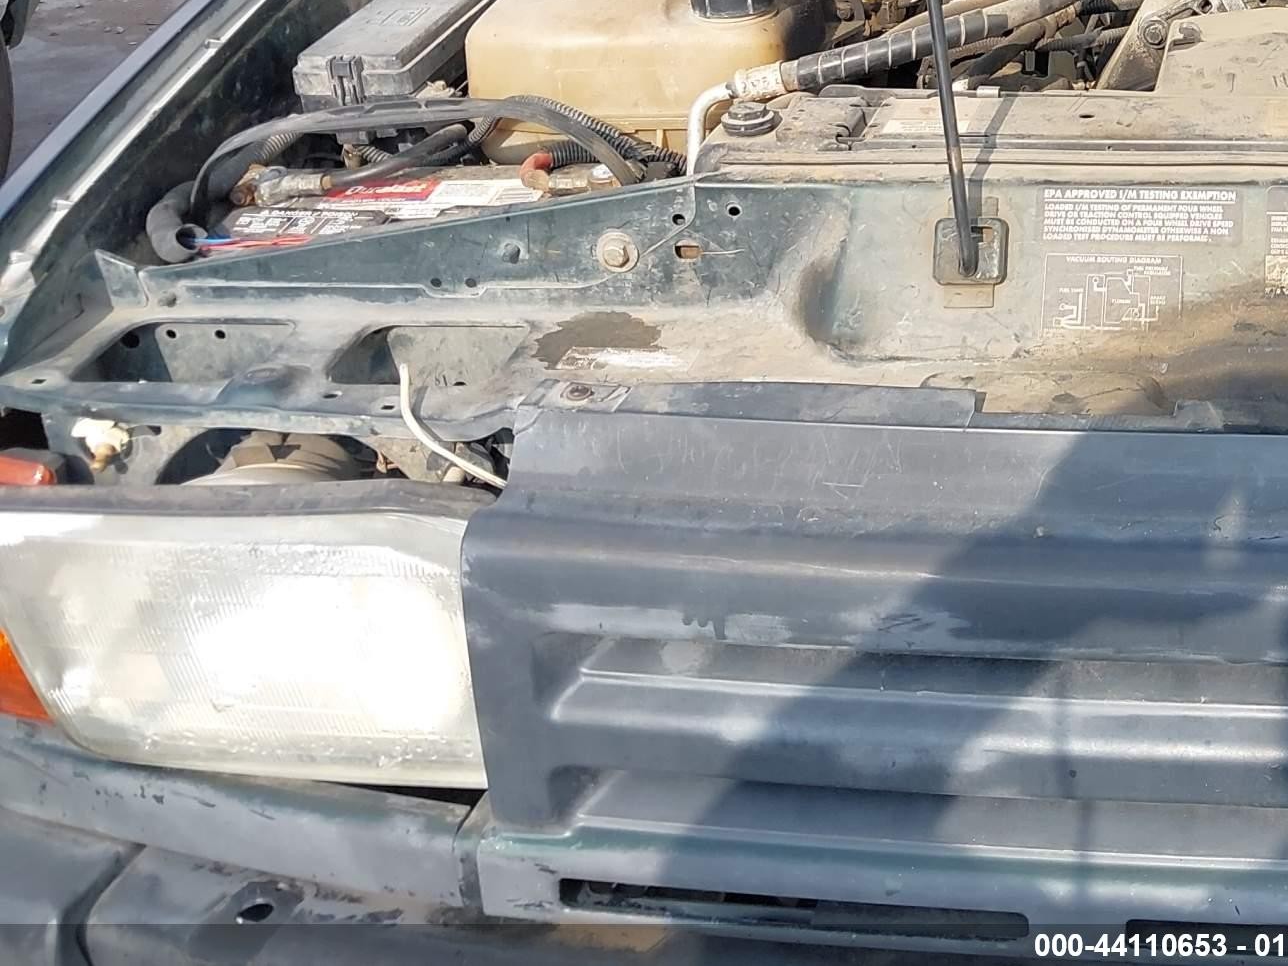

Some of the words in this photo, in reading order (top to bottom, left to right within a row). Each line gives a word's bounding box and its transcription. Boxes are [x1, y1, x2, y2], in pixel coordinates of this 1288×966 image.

[1044, 189, 1062, 199] EPA
[1064, 189, 1117, 199] APPROVED
[1120, 190, 1136, 200] I/M
[1139, 190, 1178, 200] TESTING
[1180, 190, 1236, 200] EXEMPTION
